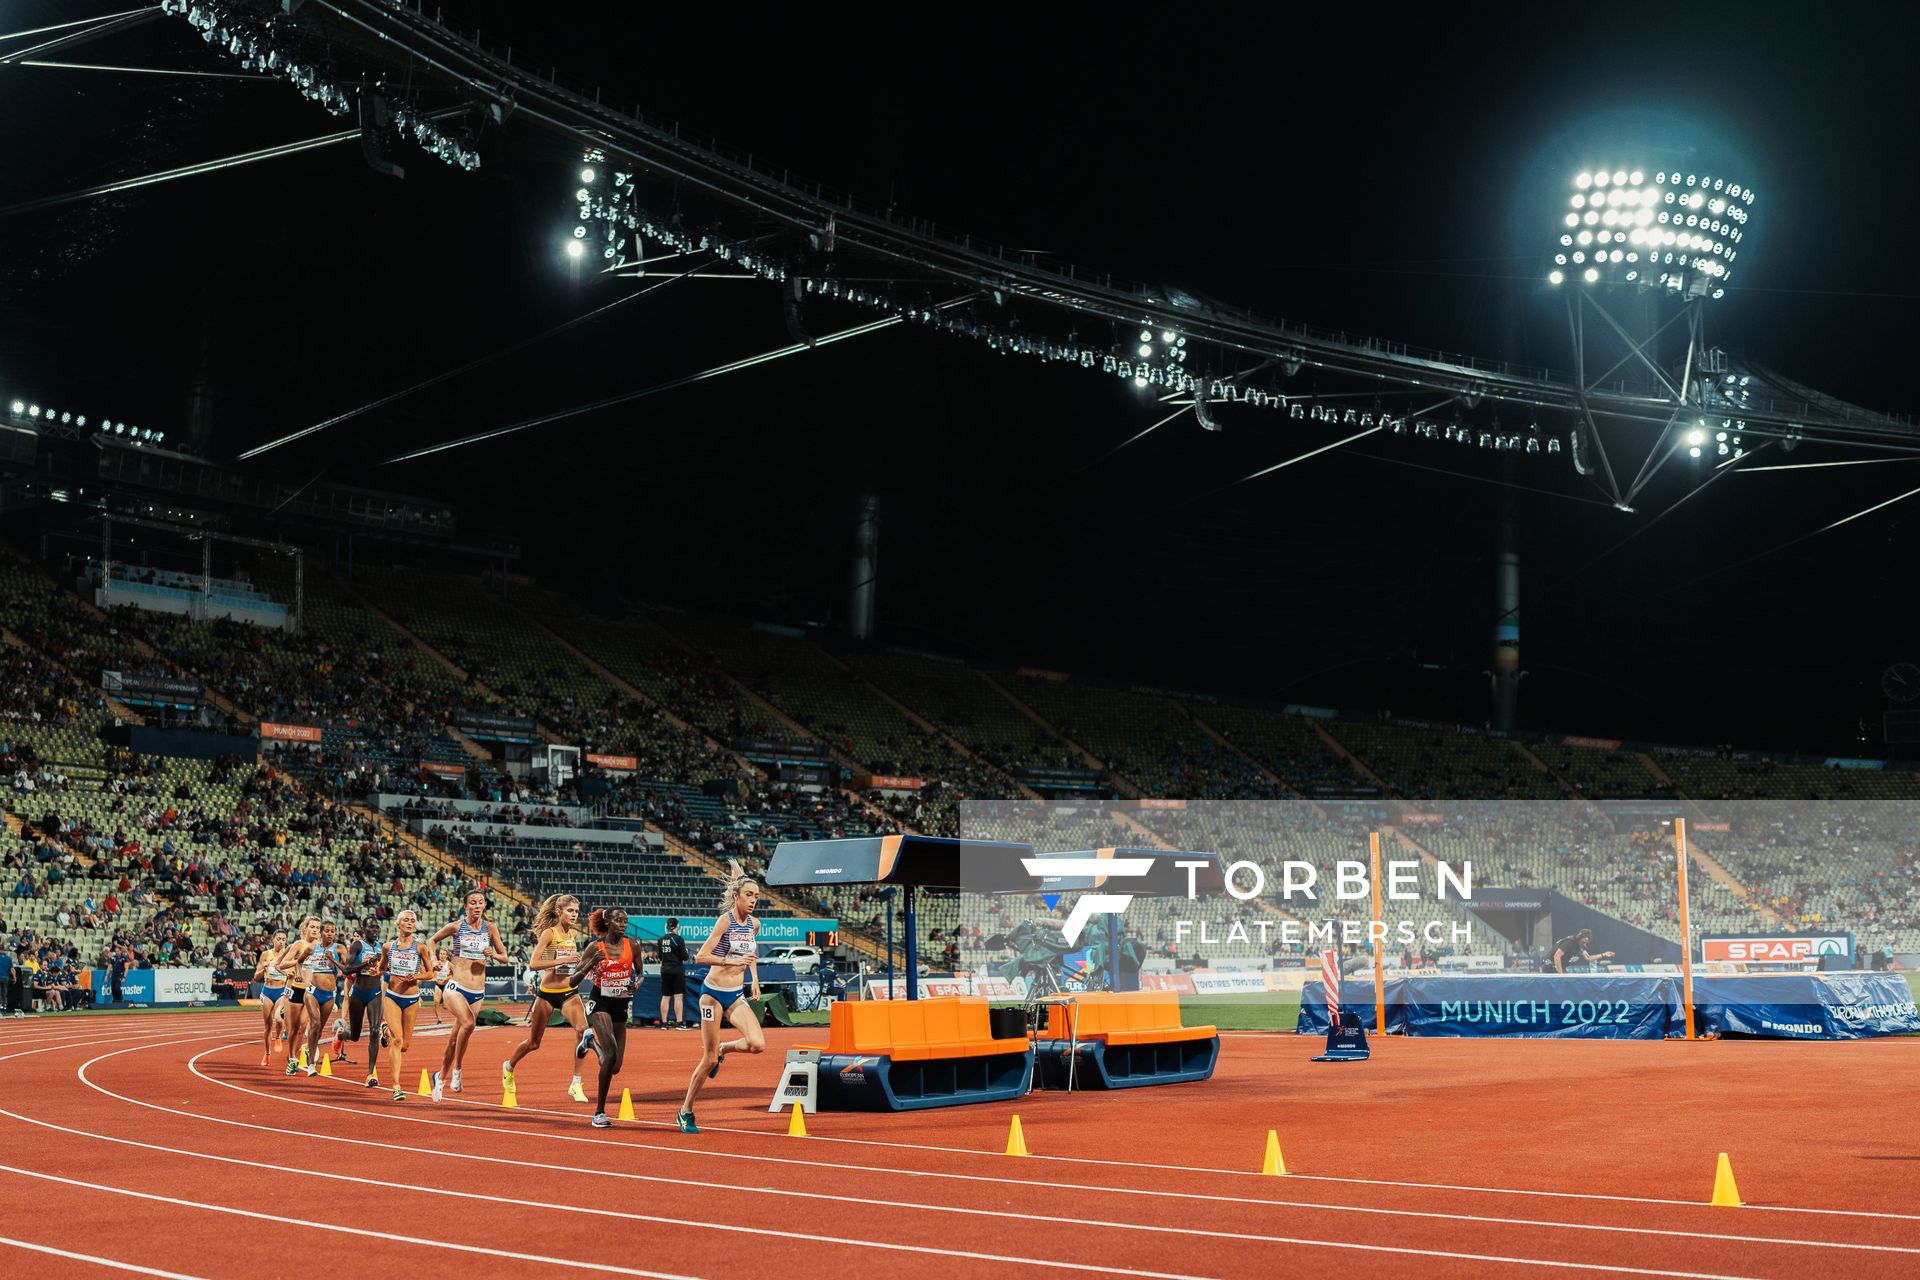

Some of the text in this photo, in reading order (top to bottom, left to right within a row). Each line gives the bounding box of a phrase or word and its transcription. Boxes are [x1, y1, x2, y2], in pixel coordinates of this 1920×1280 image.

[809, 931, 816, 947] 21
[828, 931, 839, 947] 21
[1728, 943, 1812, 958] SPAR
[174, 982, 208, 994] REGUPOL
[882, 987, 907, 999] SPA
[935, 984, 966, 996] SPAR
[702, 1007, 712, 1019] 18
[1441, 999, 1630, 1024] MUNICH 2022
[1773, 1022, 1823, 1034] MONDO
